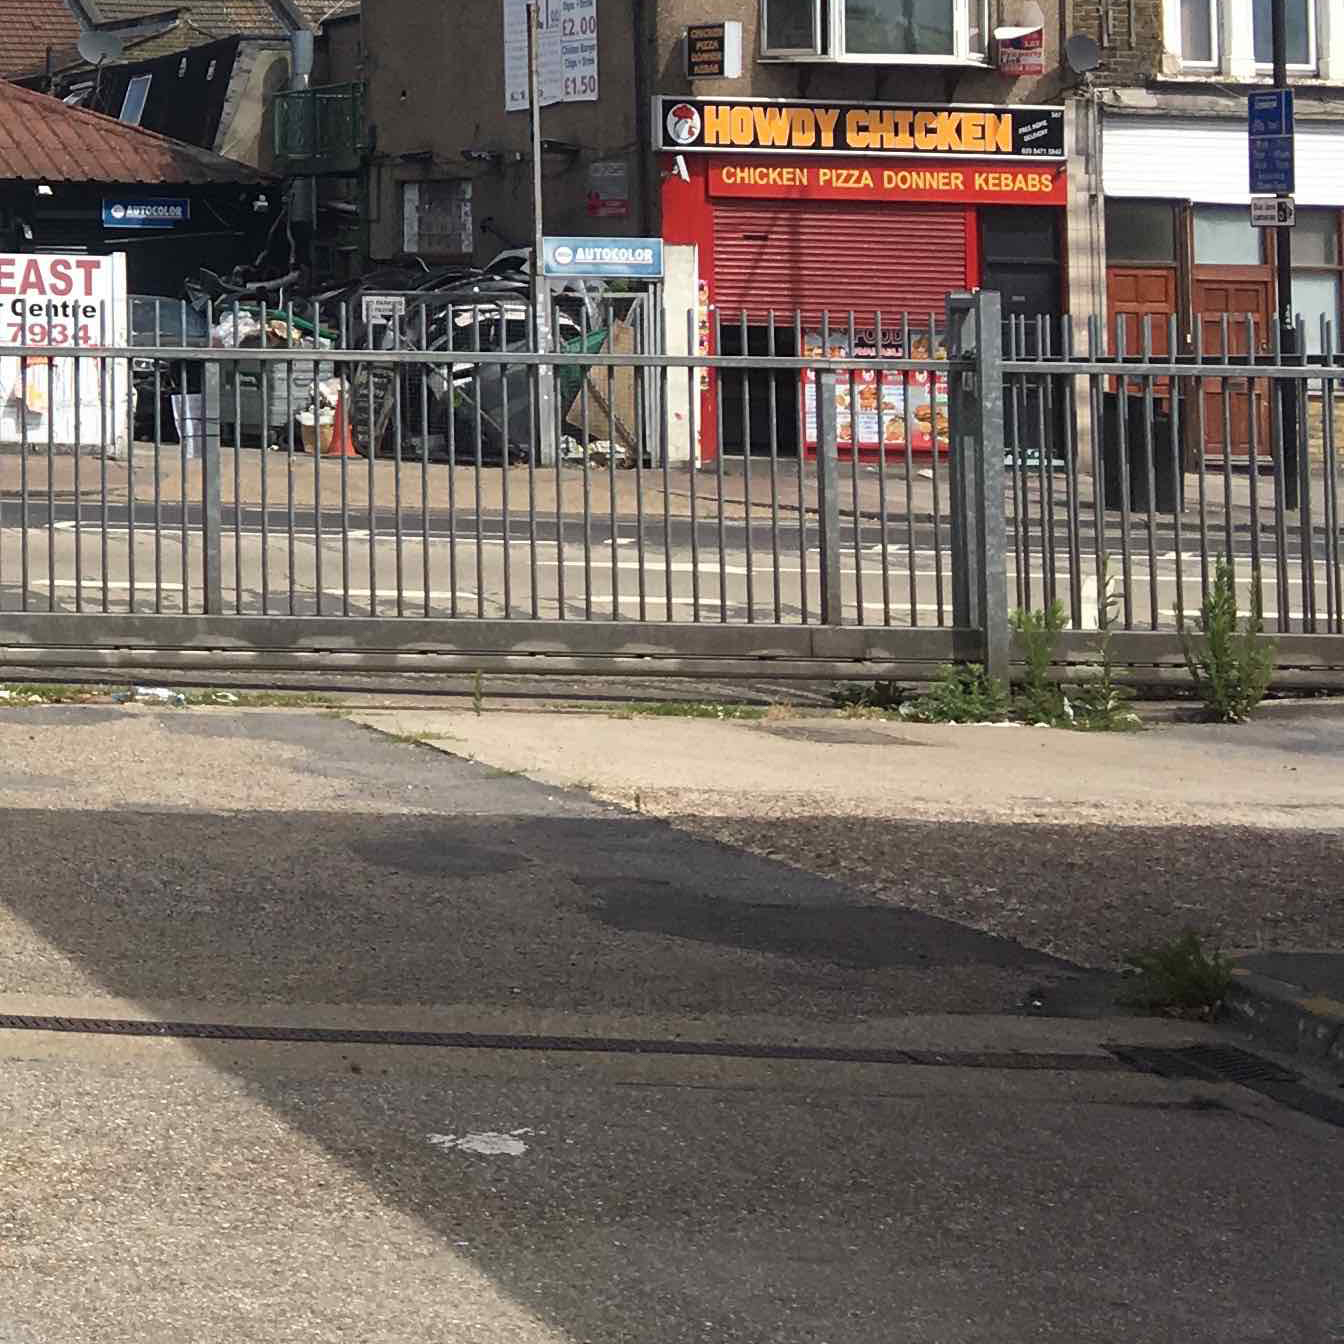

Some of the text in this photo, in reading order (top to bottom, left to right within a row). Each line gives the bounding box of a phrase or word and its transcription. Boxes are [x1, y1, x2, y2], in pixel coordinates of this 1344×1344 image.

[562, 15, 596, 36] £2.00
[564, 74, 596, 95] £1.50
[703, 105, 1012, 152] HOWDY CHICKEN
[721, 165, 1053, 192] CHICKEN PIZZA DONNER KEBABS
[126, 205, 183, 217] AUTOCOLOR
[575, 247, 654, 262] AUTOCOLOR
[11, 298, 97, 318] Centre
[6, 323, 92, 345] 7934
